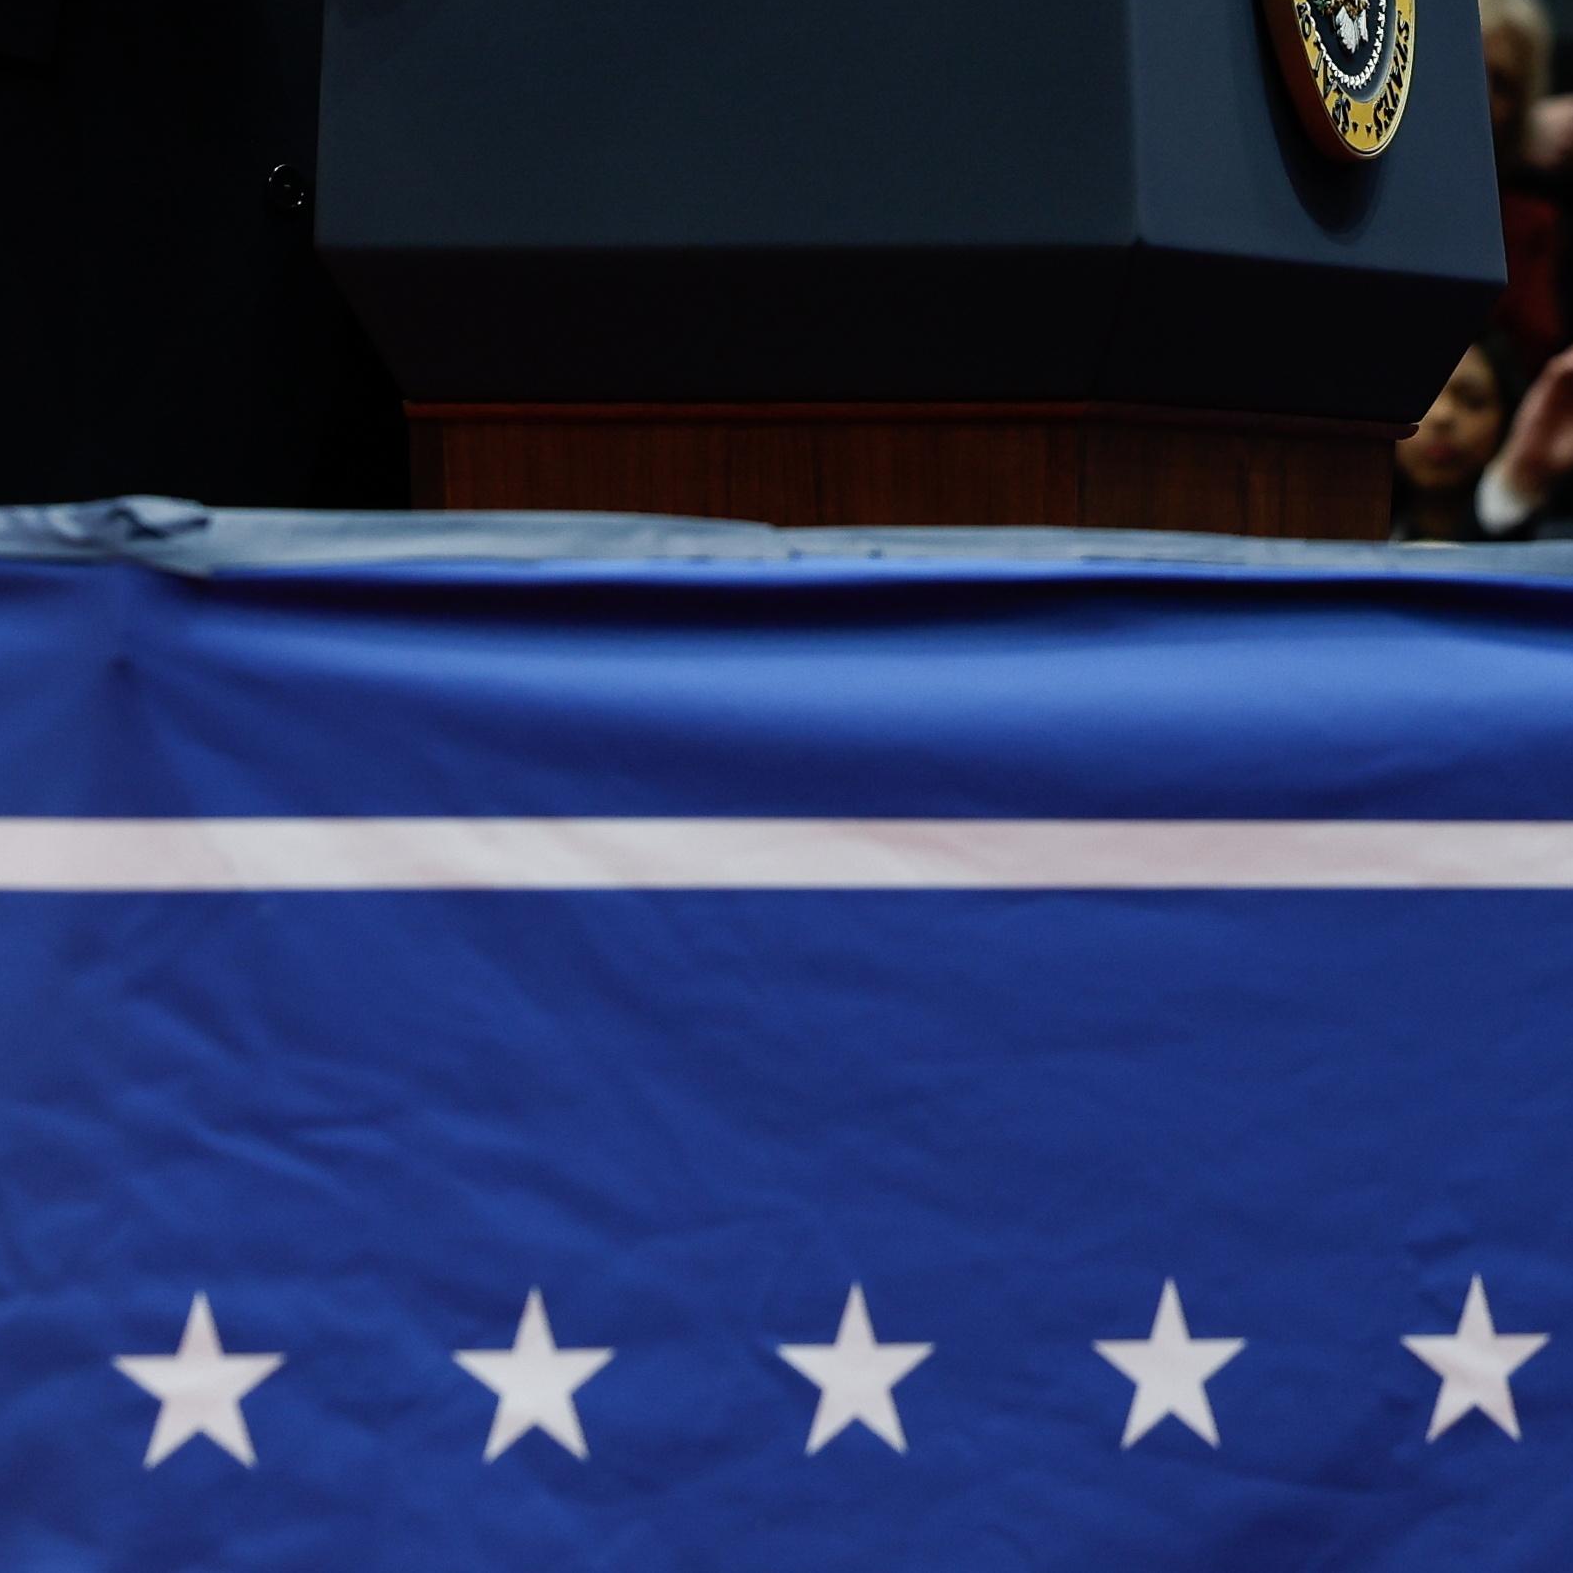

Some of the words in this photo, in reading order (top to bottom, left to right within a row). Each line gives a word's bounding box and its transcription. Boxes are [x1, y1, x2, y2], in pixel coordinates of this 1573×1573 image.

[1296, 1, 1312, 41] OF
[1311, 39, 1352, 134] SEAL
[1373, 10, 1410, 141] STATES
